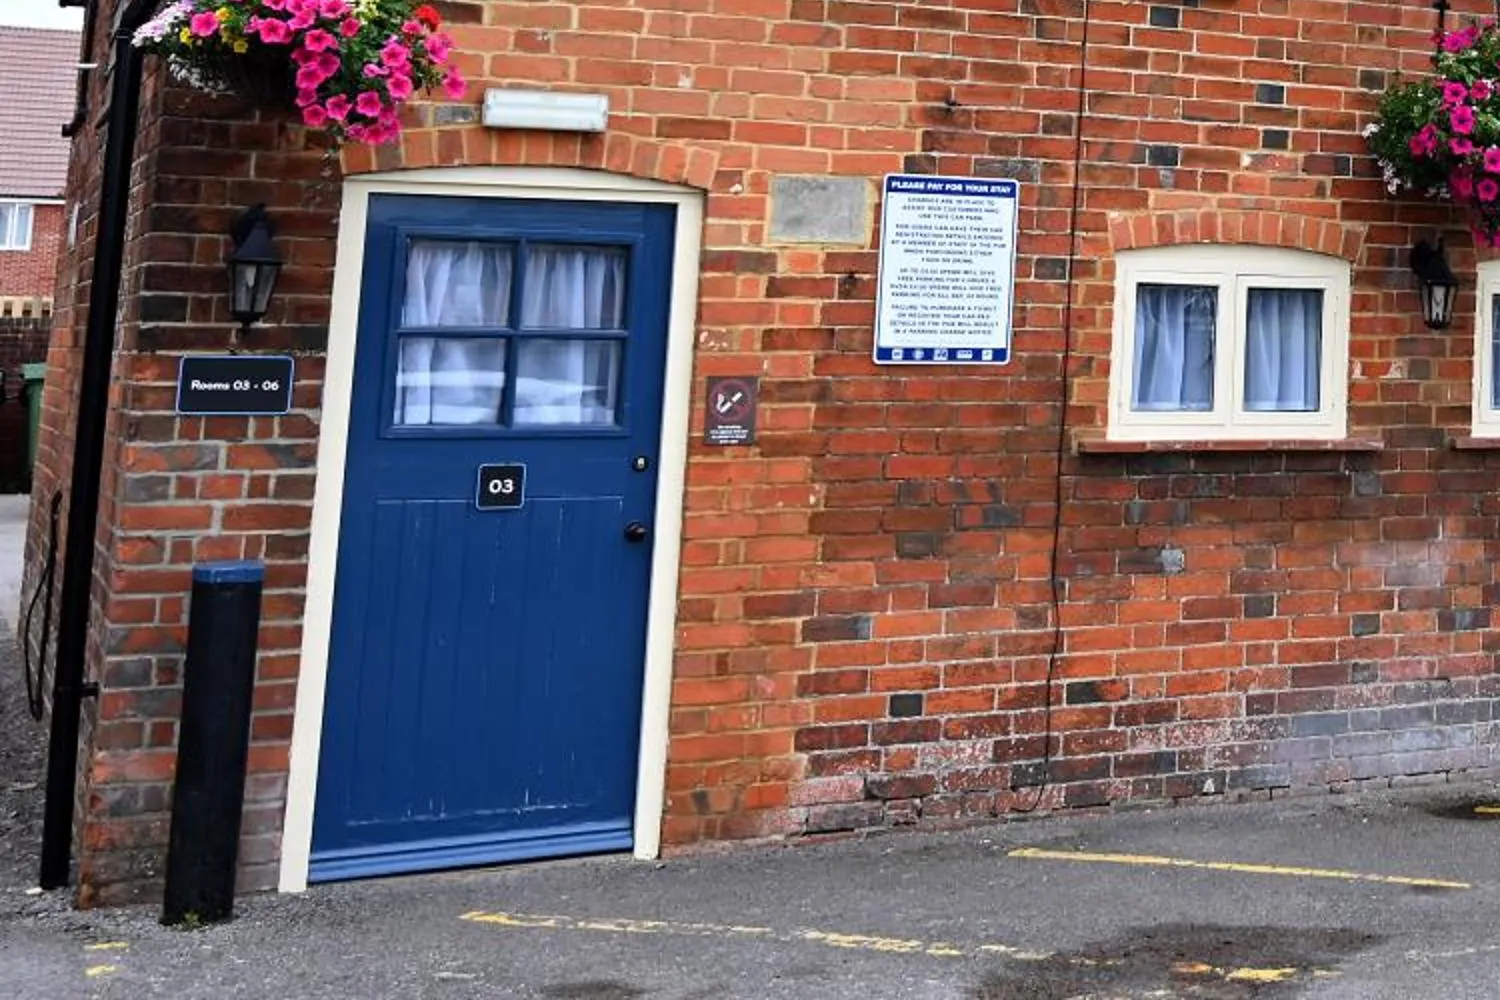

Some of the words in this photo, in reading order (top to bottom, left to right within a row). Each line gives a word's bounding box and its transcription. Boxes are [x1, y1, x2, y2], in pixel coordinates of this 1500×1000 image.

[891, 181, 924, 190] PLEASE
[928, 182, 942, 190] PAY
[946, 182, 962, 191] FOR
[966, 183, 988, 192] YOUR
[990, 184, 1012, 193] STAY
[191, 379, 230, 391] Rooms
[233, 379, 251, 391] 03
[261, 380, 279, 391] 06
[489, 478, 514, 494] 03
